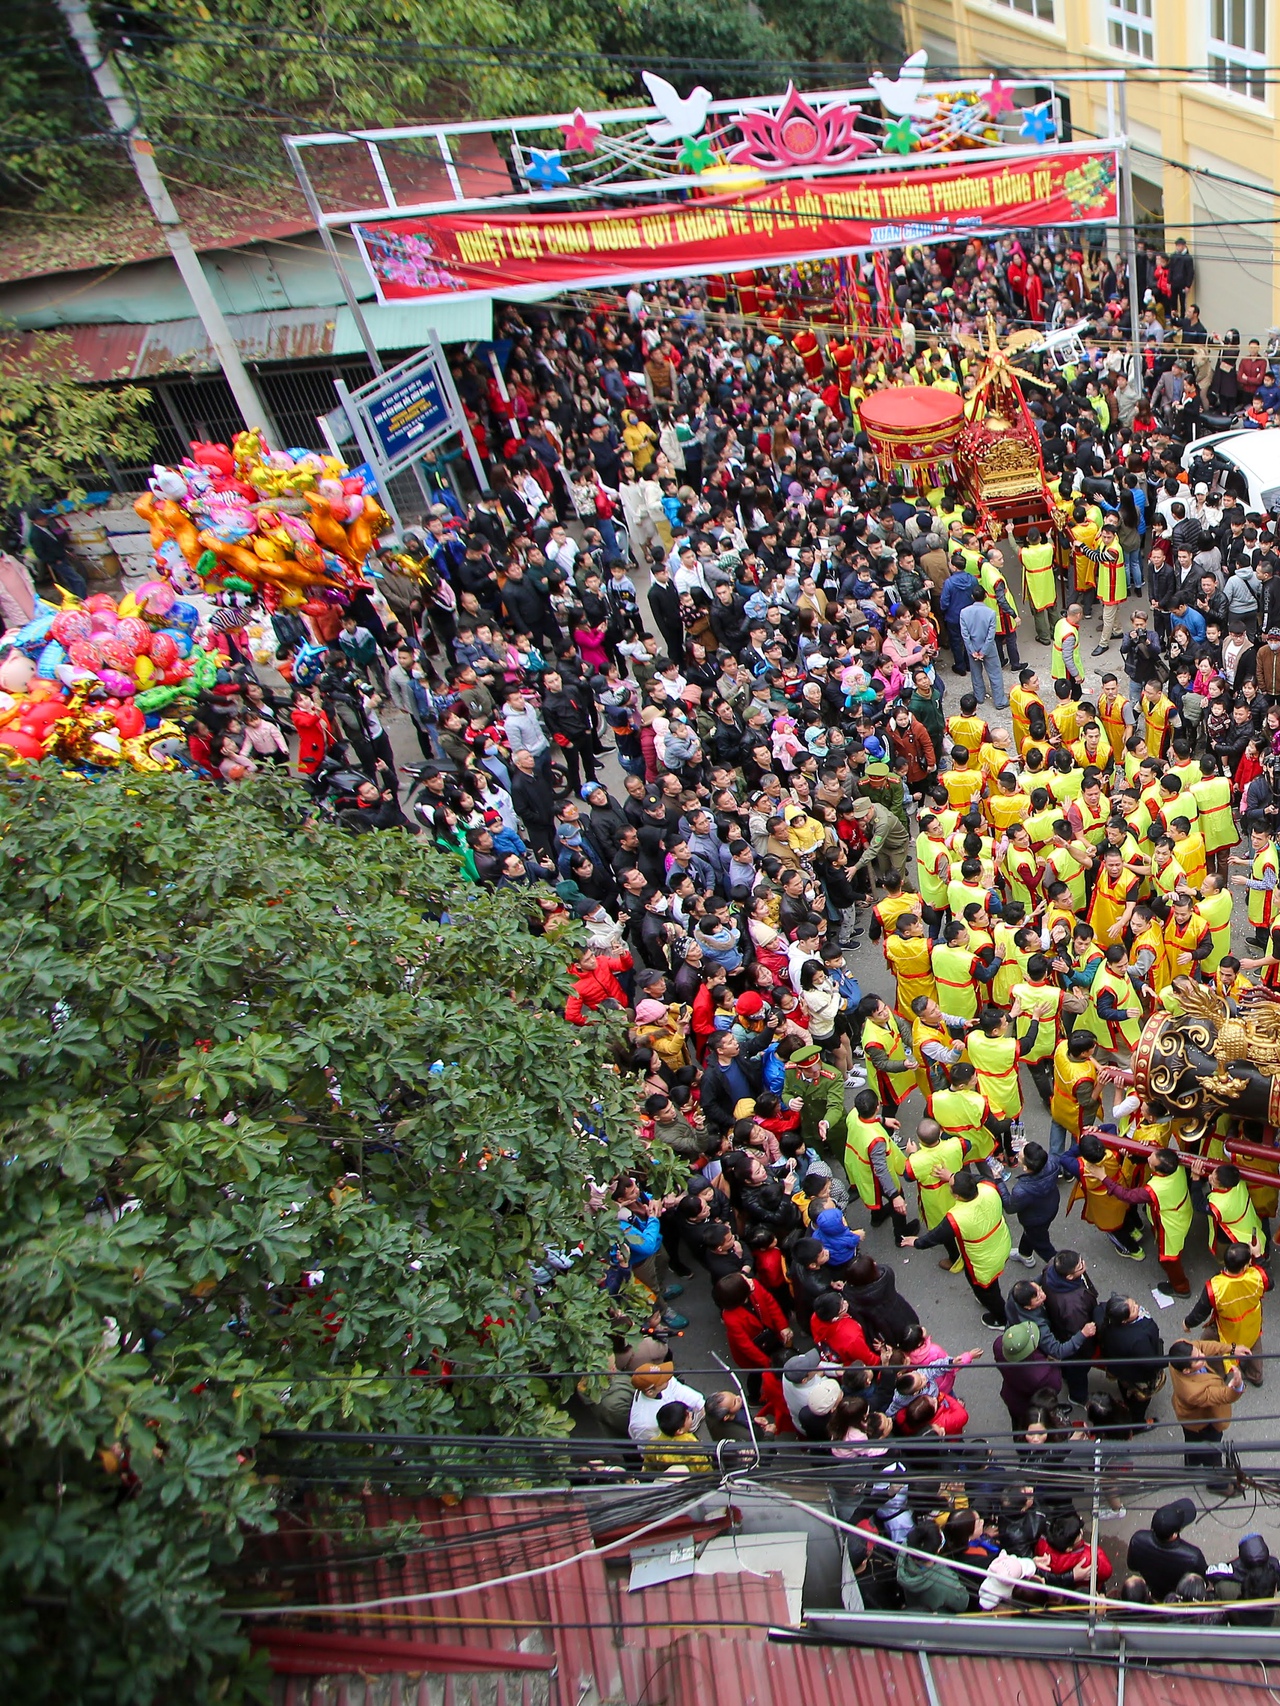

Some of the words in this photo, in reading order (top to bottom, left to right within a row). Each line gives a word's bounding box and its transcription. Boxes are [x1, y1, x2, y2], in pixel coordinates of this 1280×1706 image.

[455, 222, 508, 267] NHIỆT
[506, 222, 544, 262] LIỆT
[545, 219, 590, 254] CHÀO
[590, 214, 641, 251] MỪNG
[677, 205, 728, 242] KHÁCH
[729, 194, 751, 236] VỀ
[749, 196, 774, 239] DỰ
[773, 186, 796, 230] LỄ
[794, 189, 823, 233] HỘI
[824, 180, 881, 223] TRUYỀN
[883, 177, 930, 218] THỐNG
[932, 173, 991, 209] PHƯỜNG
[992, 165, 1031, 206] ĐỒNG
[871, 223, 902, 244] XUÂN
